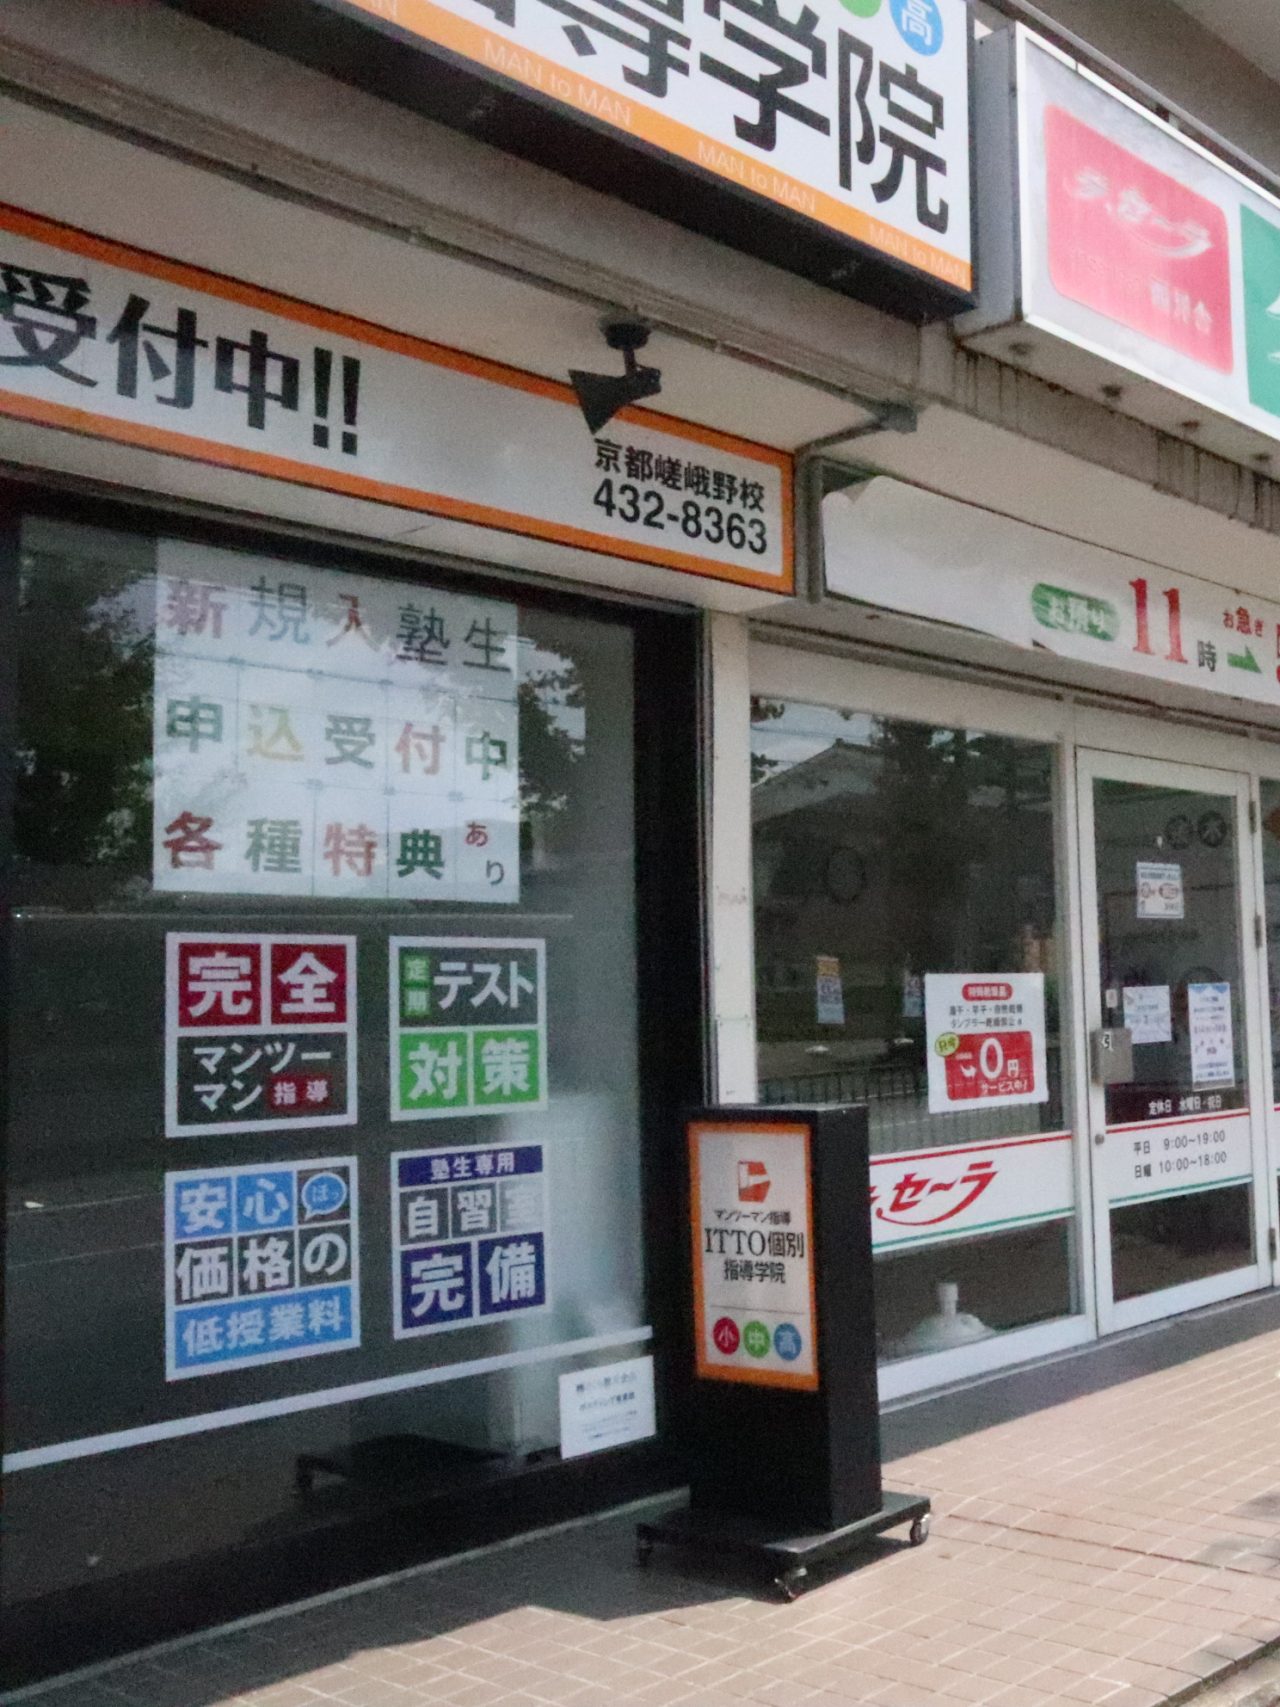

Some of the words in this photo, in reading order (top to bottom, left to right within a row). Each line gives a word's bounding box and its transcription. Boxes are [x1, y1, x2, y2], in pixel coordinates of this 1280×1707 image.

[483, 38, 543, 84] MAN
[551, 72, 572, 97] to
[579, 83, 632, 126] MAN
[699, 141, 745, 181] MAN
[751, 168, 768, 189] to
[773, 173, 816, 213] MAN
[594, 438, 766, 513] 京都嵯峨野校
[593, 478, 767, 555] 432-8363
[187, 951, 339, 1019] 完全
[433, 960, 535, 1010] テスト
[193, 1041, 332, 1075] マンツー
[408, 1037, 531, 1101] 対策
[273, 1079, 328, 1105] 指導
[430, 1151, 515, 1182] 塾生専用
[179, 1178, 290, 1235] 安心
[176, 1232, 348, 1301] 価格の
[704, 1227, 805, 1259] ITTO個別
[723, 1258, 786, 1284] 指導学院
[410, 1241, 537, 1318] 完備
[182, 1295, 344, 1358] 低授業料
[717, 1325, 735, 1348] 小
